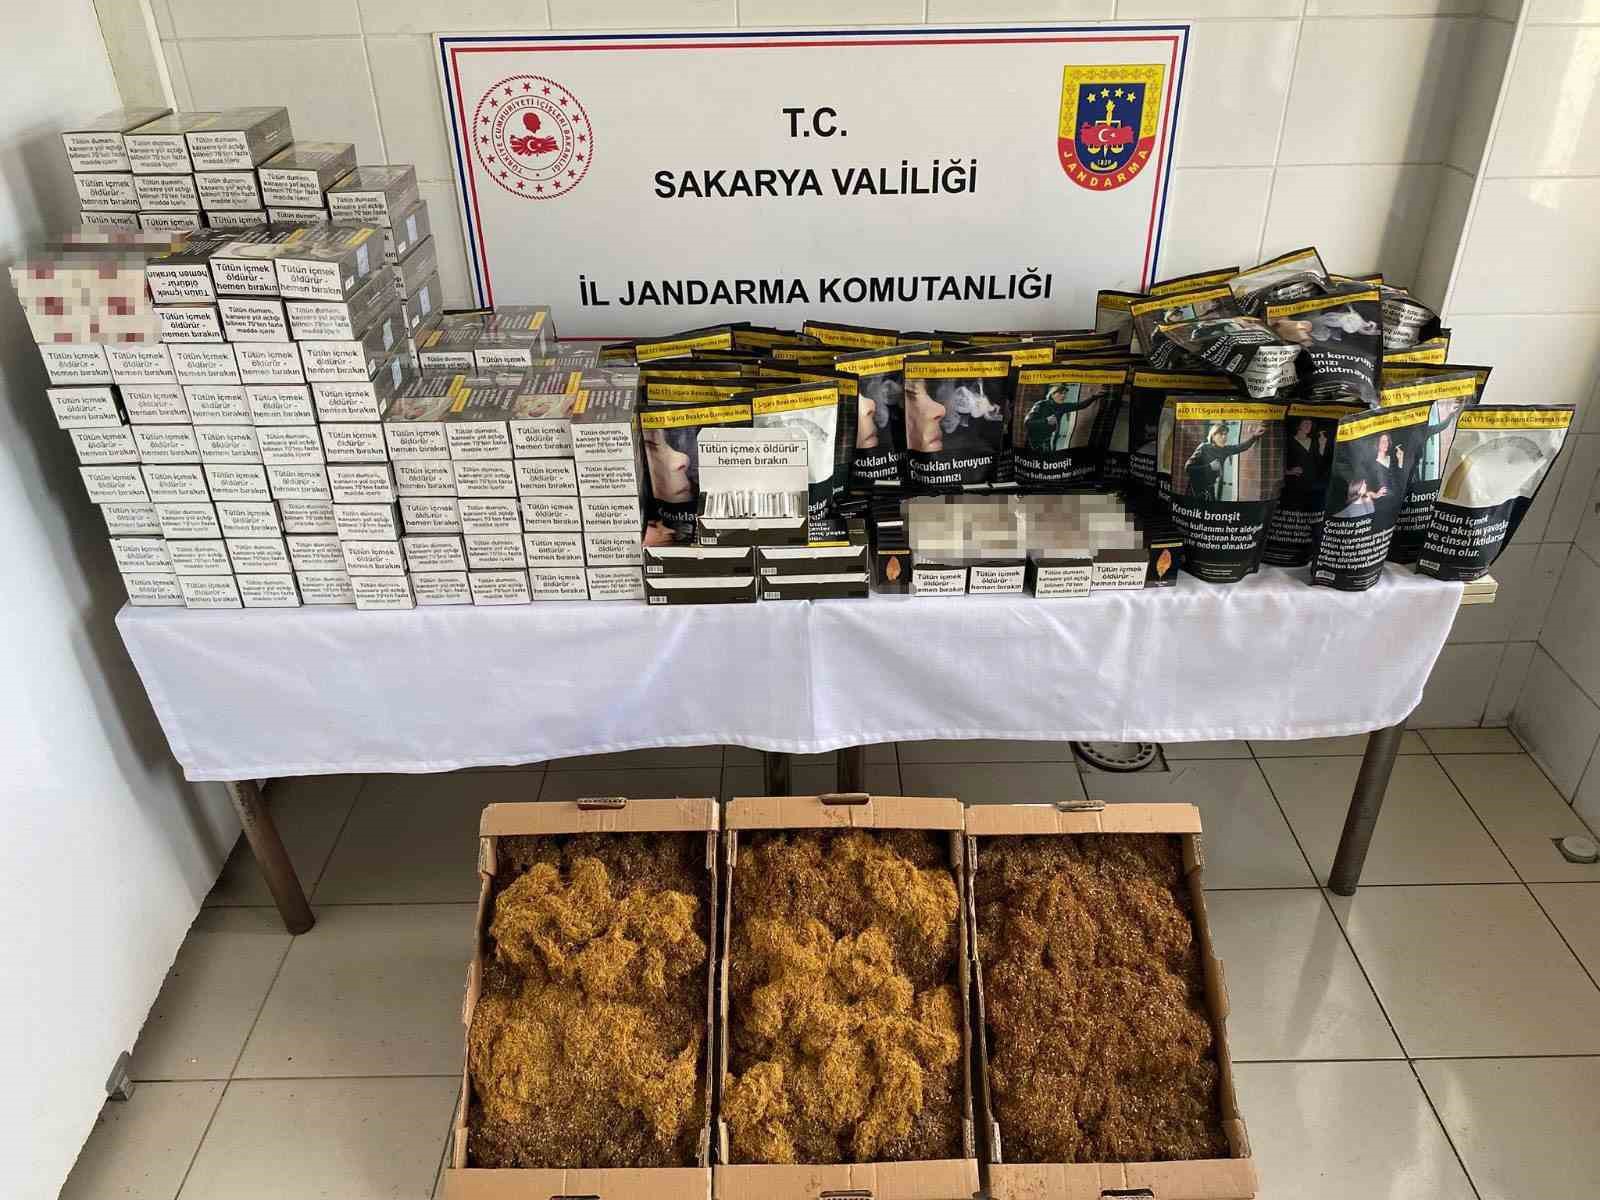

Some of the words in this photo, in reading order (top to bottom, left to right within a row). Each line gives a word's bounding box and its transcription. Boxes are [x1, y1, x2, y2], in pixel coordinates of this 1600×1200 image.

[782, 107, 847, 138] T.C.
[1063, 149, 1149, 188] JANDARMA
[654, 169, 824, 199] SAKARYA
[832, 158, 977, 196] VALİLİĞİ
[216, 264, 241, 272] Tütün
[242, 264, 270, 274] içmek
[281, 264, 307, 274] Tütün
[309, 266, 336, 277] içmek
[226, 272, 258, 281] öldürür
[216, 283, 246, 291] hemen
[248, 283, 279, 291] bırakın
[280, 284, 310, 293] hemen
[579, 274, 611, 307] İL
[619, 278, 810, 306] JANDARMA
[819, 266, 1053, 304] KOMUTANLIĞI
[160, 312, 185, 321] Tütün
[186, 312, 211, 322] içmek
[162, 330, 190, 338] hemen
[1327, 351, 1374, 371] koruyun:
[699, 443, 728, 453] Tütün
[730, 443, 761, 456] içmek
[763, 443, 800, 453] öldürür
[718, 455, 752, 465] hemen
[753, 455, 788, 465] bırakın
[855, 456, 887, 467] cukları
[952, 455, 993, 469] koruyun:
[1014, 455, 1041, 469] Kronik
[1043, 458, 1072, 470] bronşit
[856, 466, 898, 479] manınızı
[1172, 503, 1203, 520] Kronik
[1203, 510, 1241, 524] bronşit
[1433, 510, 1464, 525] Tütün
[1430, 520, 1449, 533] kan
[1427, 531, 1440, 541] ve
[1441, 534, 1472, 547] cinsel
[1423, 542, 1456, 556] neden
[1457, 548, 1480, 558] olur.
